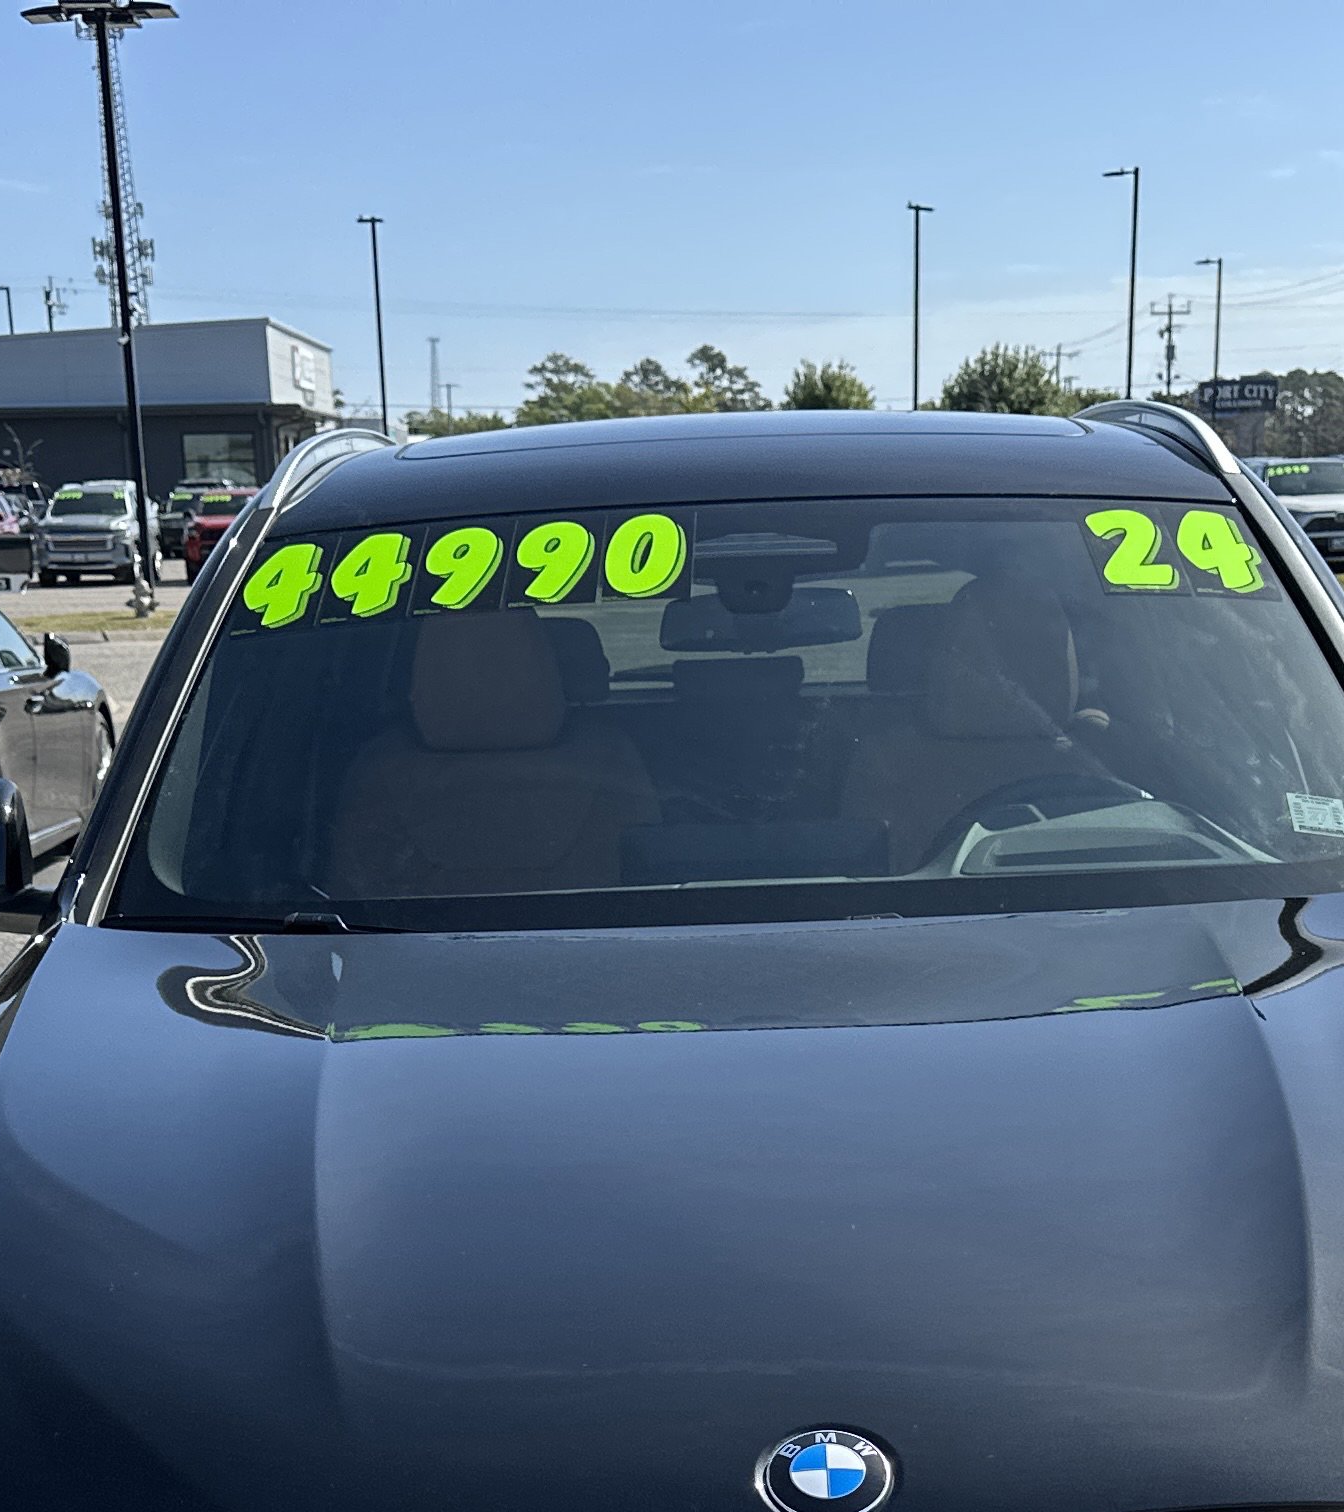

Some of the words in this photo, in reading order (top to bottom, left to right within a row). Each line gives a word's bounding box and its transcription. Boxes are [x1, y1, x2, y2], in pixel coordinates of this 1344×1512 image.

[1244, 384, 1275, 400] CITY
[243, 514, 687, 629] 44990
[1085, 509, 1264, 594] 24
[776, 1432, 878, 1459] BMW
